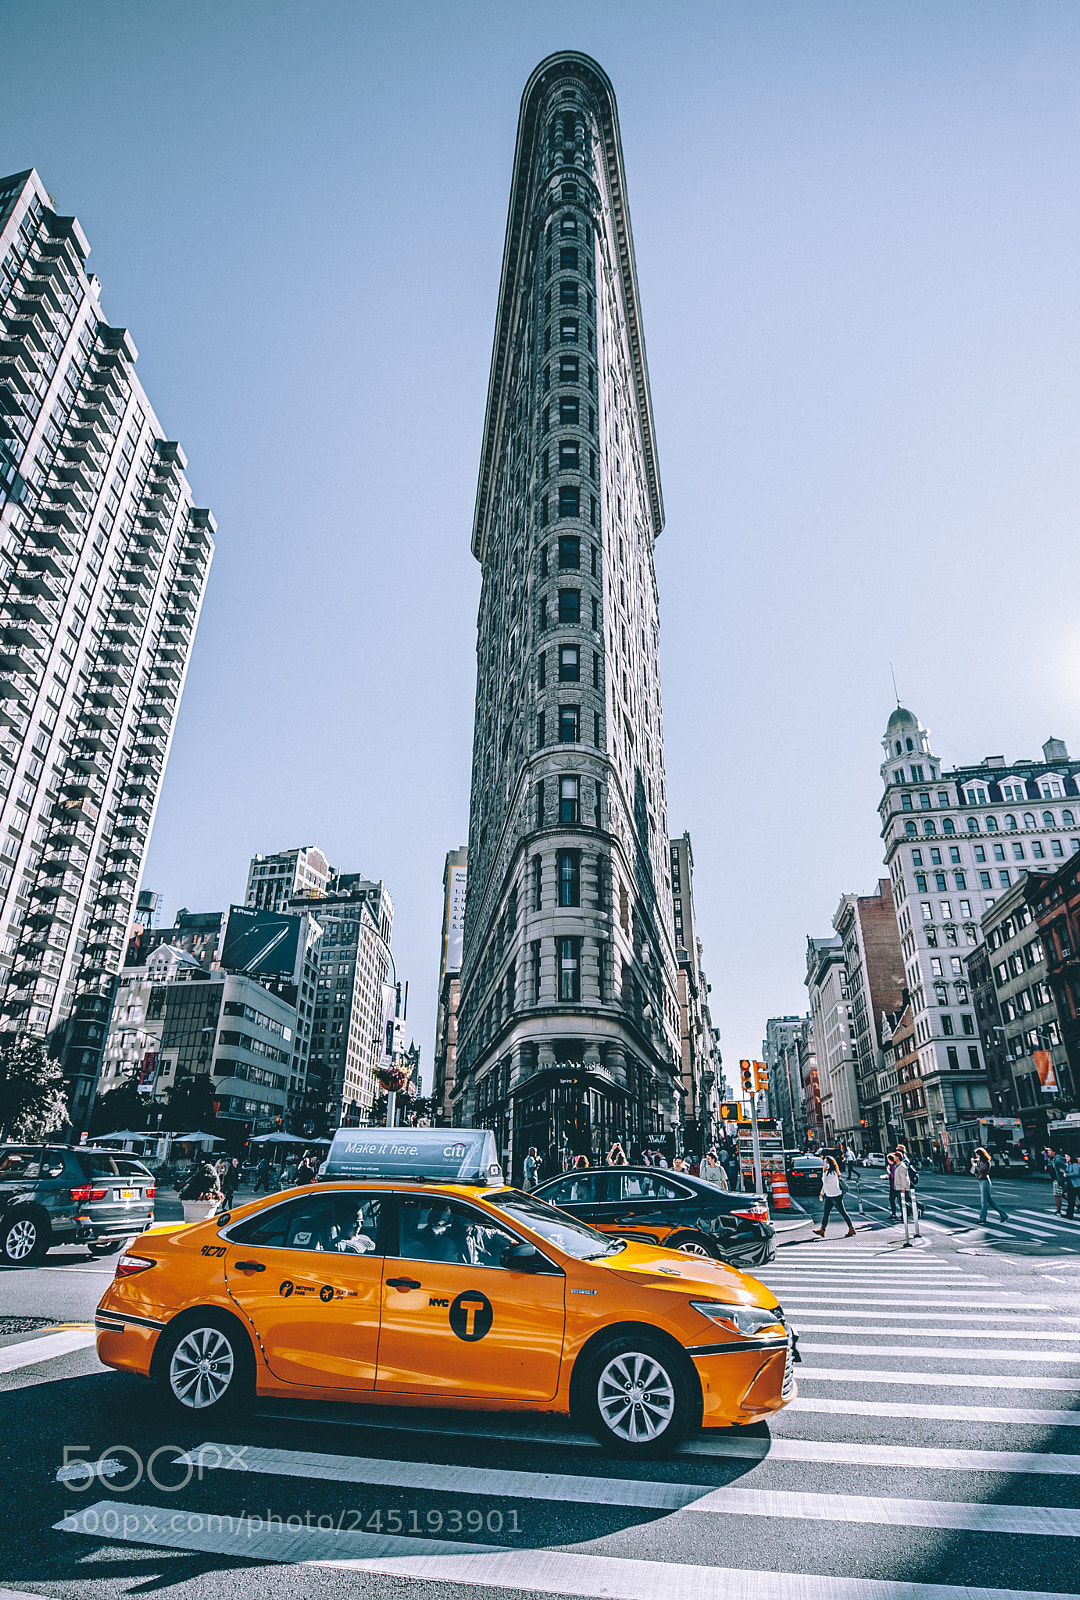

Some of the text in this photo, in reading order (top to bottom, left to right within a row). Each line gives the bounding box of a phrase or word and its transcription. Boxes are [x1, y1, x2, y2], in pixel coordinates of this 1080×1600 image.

[238, 908, 254, 916] iPhone
[344, 1142, 419, 1156] Make it here.
[443, 1143, 466, 1157] citi
[429, 1298, 484, 1335] NYC T
